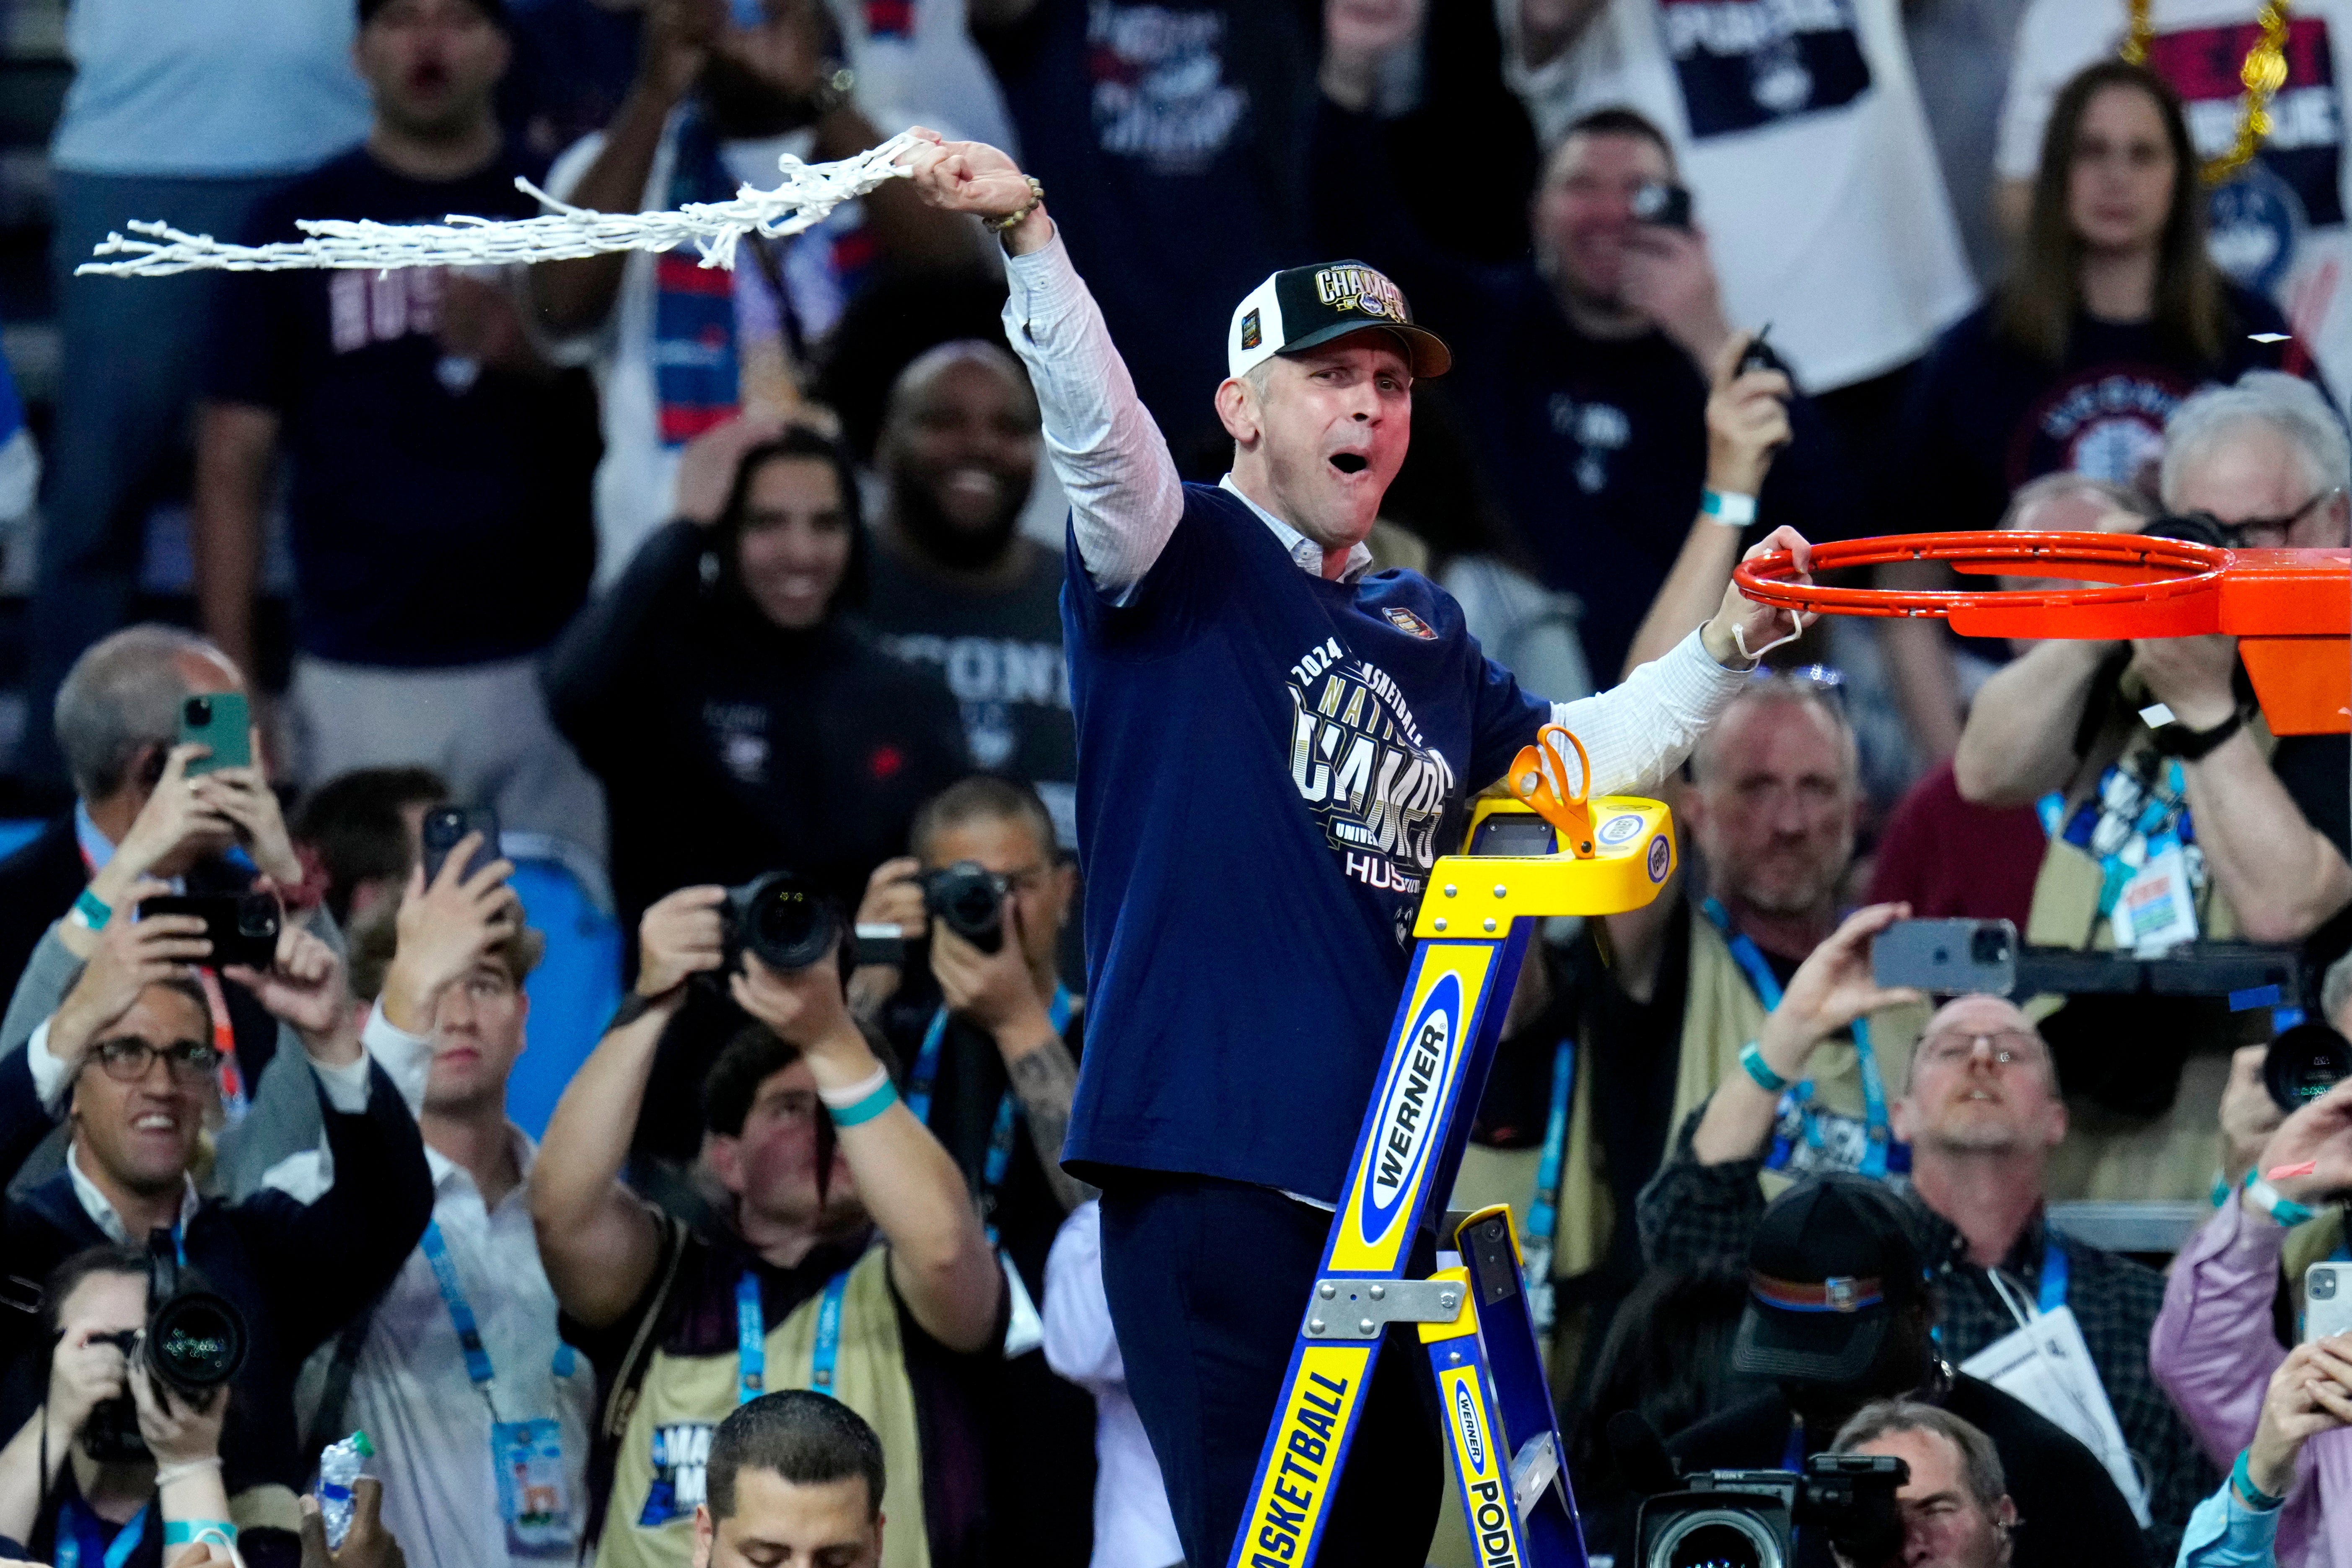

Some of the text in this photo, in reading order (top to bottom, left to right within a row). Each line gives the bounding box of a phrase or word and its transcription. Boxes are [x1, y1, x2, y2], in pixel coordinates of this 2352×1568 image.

[1291, 637, 1344, 687] 2024
[1354, 660, 1423, 748] ASKETBALL
[1376, 1024, 1445, 1189] WERNER
[1461, 1398, 1480, 1458] WERNER
